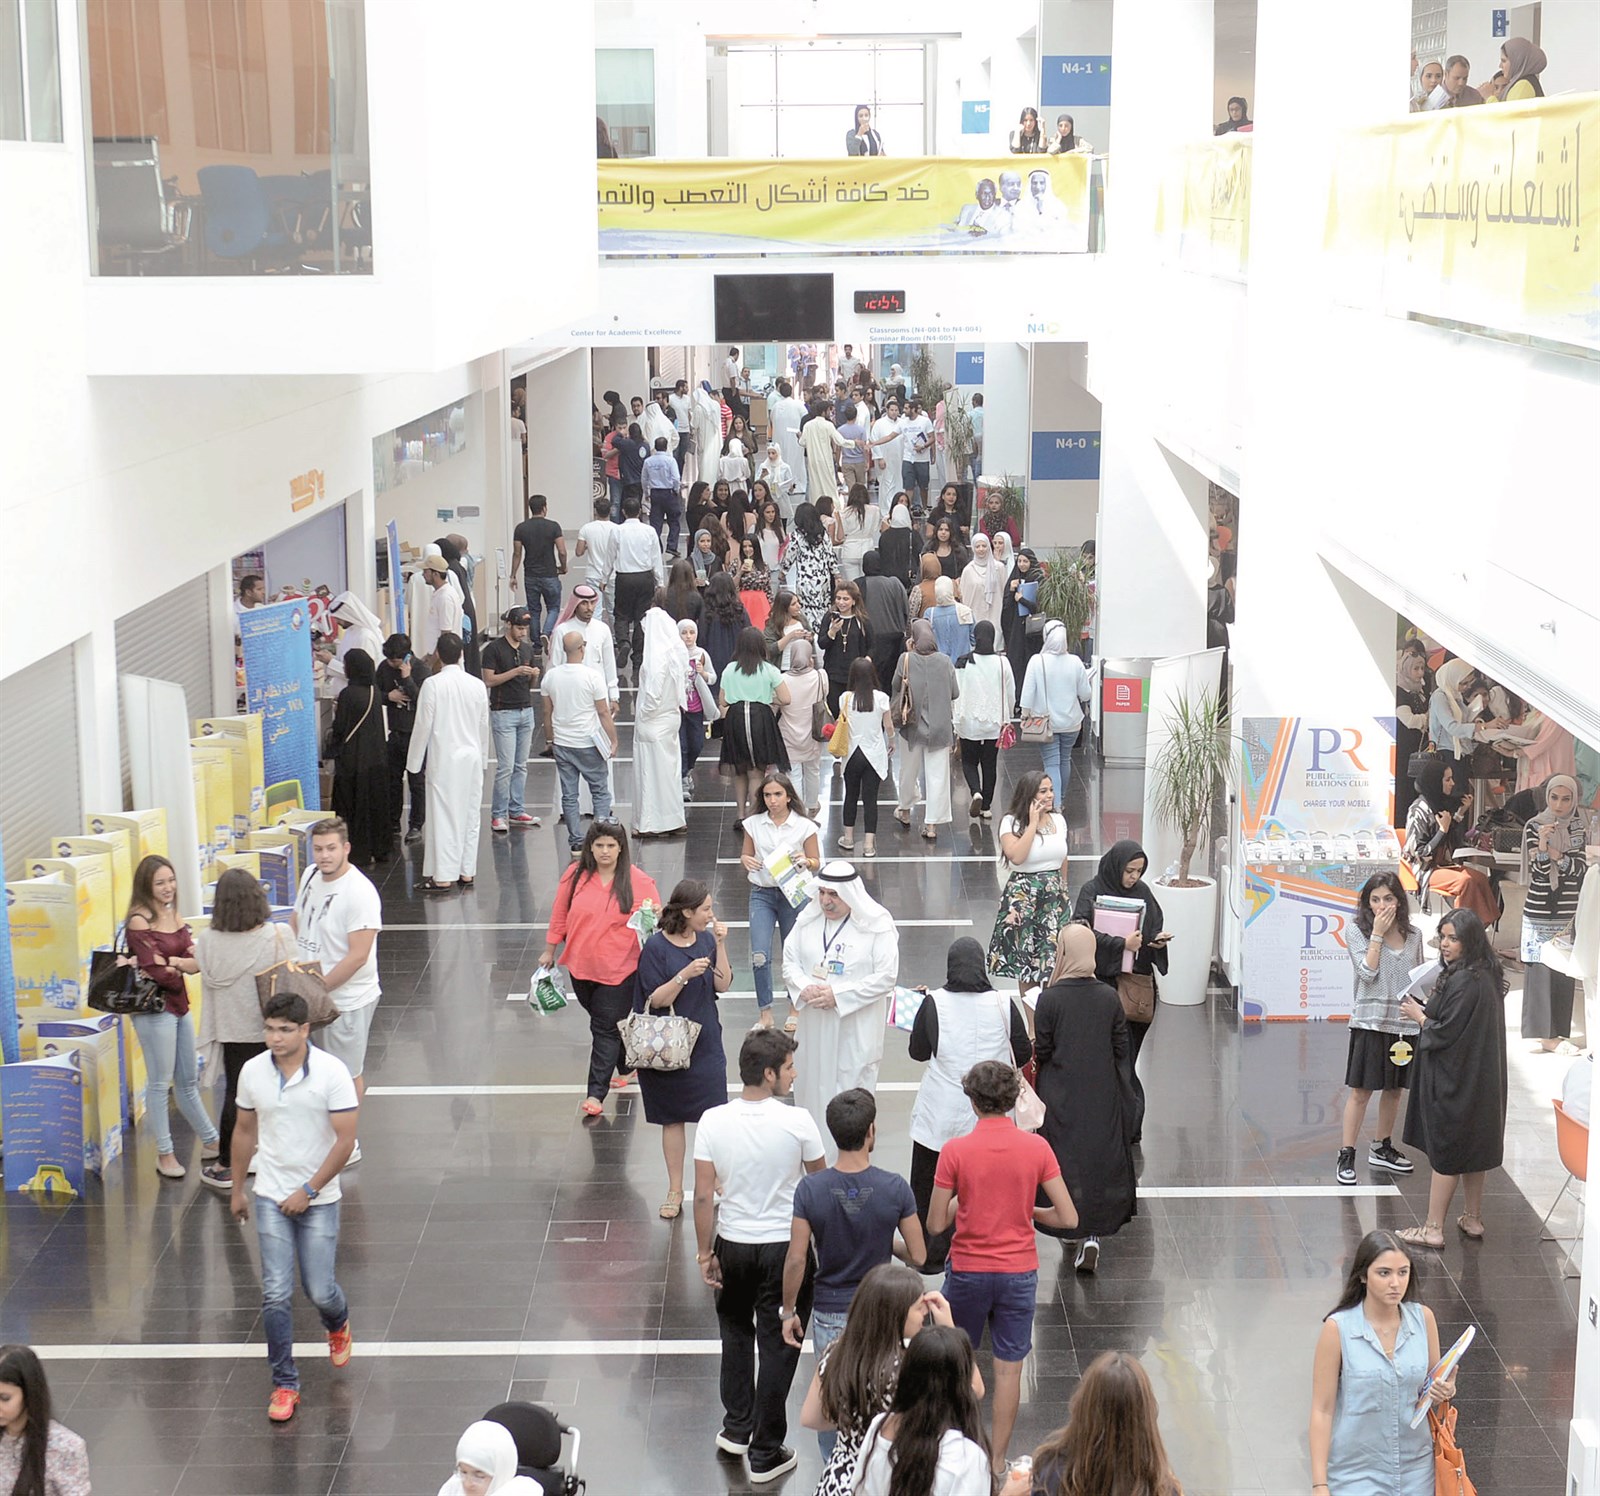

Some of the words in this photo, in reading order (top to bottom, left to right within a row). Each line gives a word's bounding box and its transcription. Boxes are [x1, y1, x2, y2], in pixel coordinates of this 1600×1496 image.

[1062, 63, 1093, 74] N4-1
[663, 182, 747, 212] التعصب
[755, 176, 827, 212] أشكال
[836, 181, 888, 202] كافة
[896, 183, 929, 201] ضد
[1056, 438, 1087, 449] N4-0
[1251, 753, 1265, 761] PR
[1306, 728, 1369, 771] PR
[1303, 800, 1327, 808] CHARGE
[1329, 800, 1345, 808] YOUR
[1301, 914, 1348, 949] PR
